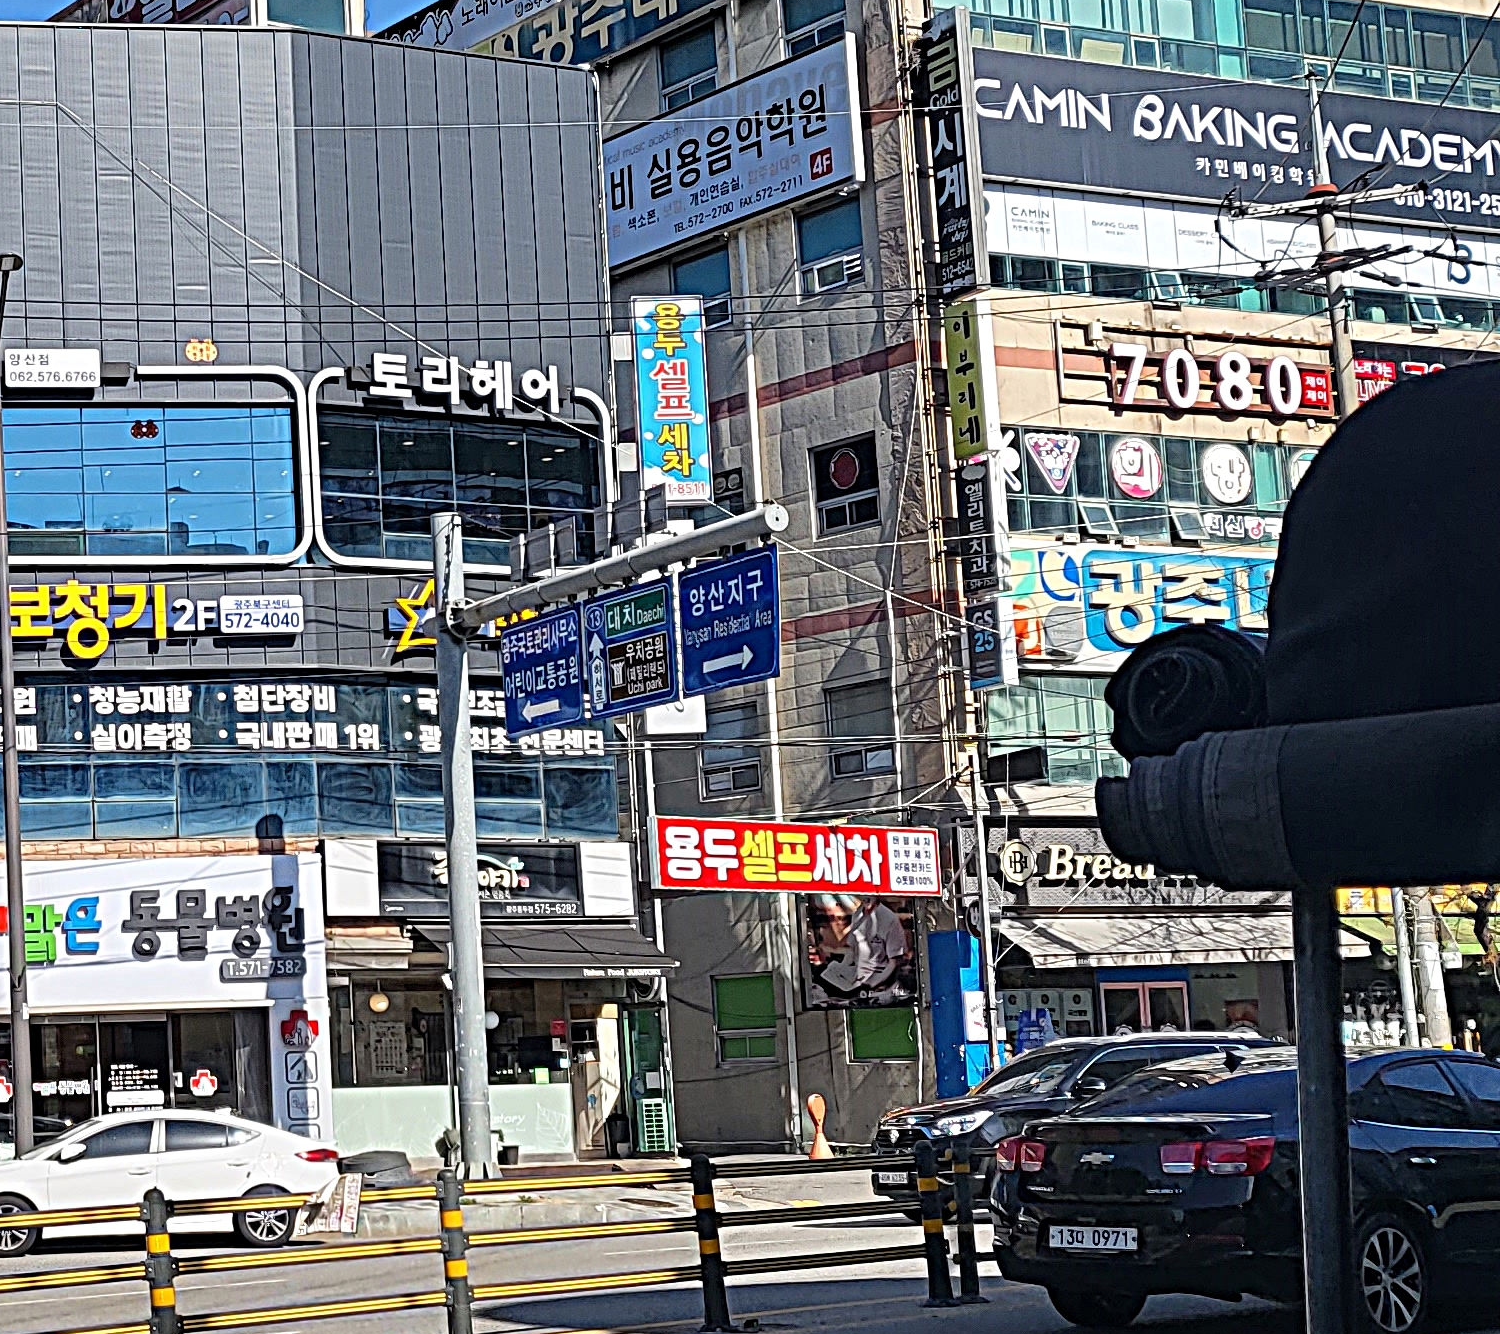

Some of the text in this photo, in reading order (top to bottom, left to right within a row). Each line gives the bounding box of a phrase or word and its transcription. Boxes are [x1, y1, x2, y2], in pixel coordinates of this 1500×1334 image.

[927, 36, 958, 92] 금
[929, 84, 960, 111] Gold
[975, 76, 1113, 132] CAMIN
[1133, 94, 1300, 153] BAKING
[647, 83, 827, 200] 실용음악학원
[812, 153, 831, 176] 4F
[933, 111, 968, 209] 시계
[1010, 206, 1050, 219] CAMIN
[9, 352, 51, 367] 양산점
[9, 370, 97, 385] 062.576.6766
[368, 352, 560, 414] 토리헤어
[1108, 342, 1302, 415] 7080
[234, 598, 290, 611] 광주북구센터
[689, 569, 764, 617] 양산지구
[172, 597, 218, 632] 2F
[224, 611, 300, 630] 572-4040
[588, 611, 602, 628] 13
[607, 602, 665, 631] 대치 Daechi
[754, 609, 773, 630] Area
[501, 620, 578, 664] 광주국토관리사무소
[625, 635, 664, 665] 우치공원
[505, 655, 579, 699] 어린이교통공원
[627, 676, 663, 695] Uchi park
[88, 686, 193, 715] 청능재활
[233, 685, 336, 714] 첨단장비
[235, 721, 338, 750] 국내판매
[345, 722, 380, 751] 1위
[665, 825, 883, 886] 용두셀프세차
[121, 885, 306, 962] 동물병원
[534, 903, 577, 915] 575-6282
[226, 959, 302, 977] T.571-7582
[1092, 1229, 1129, 1246] 0971
